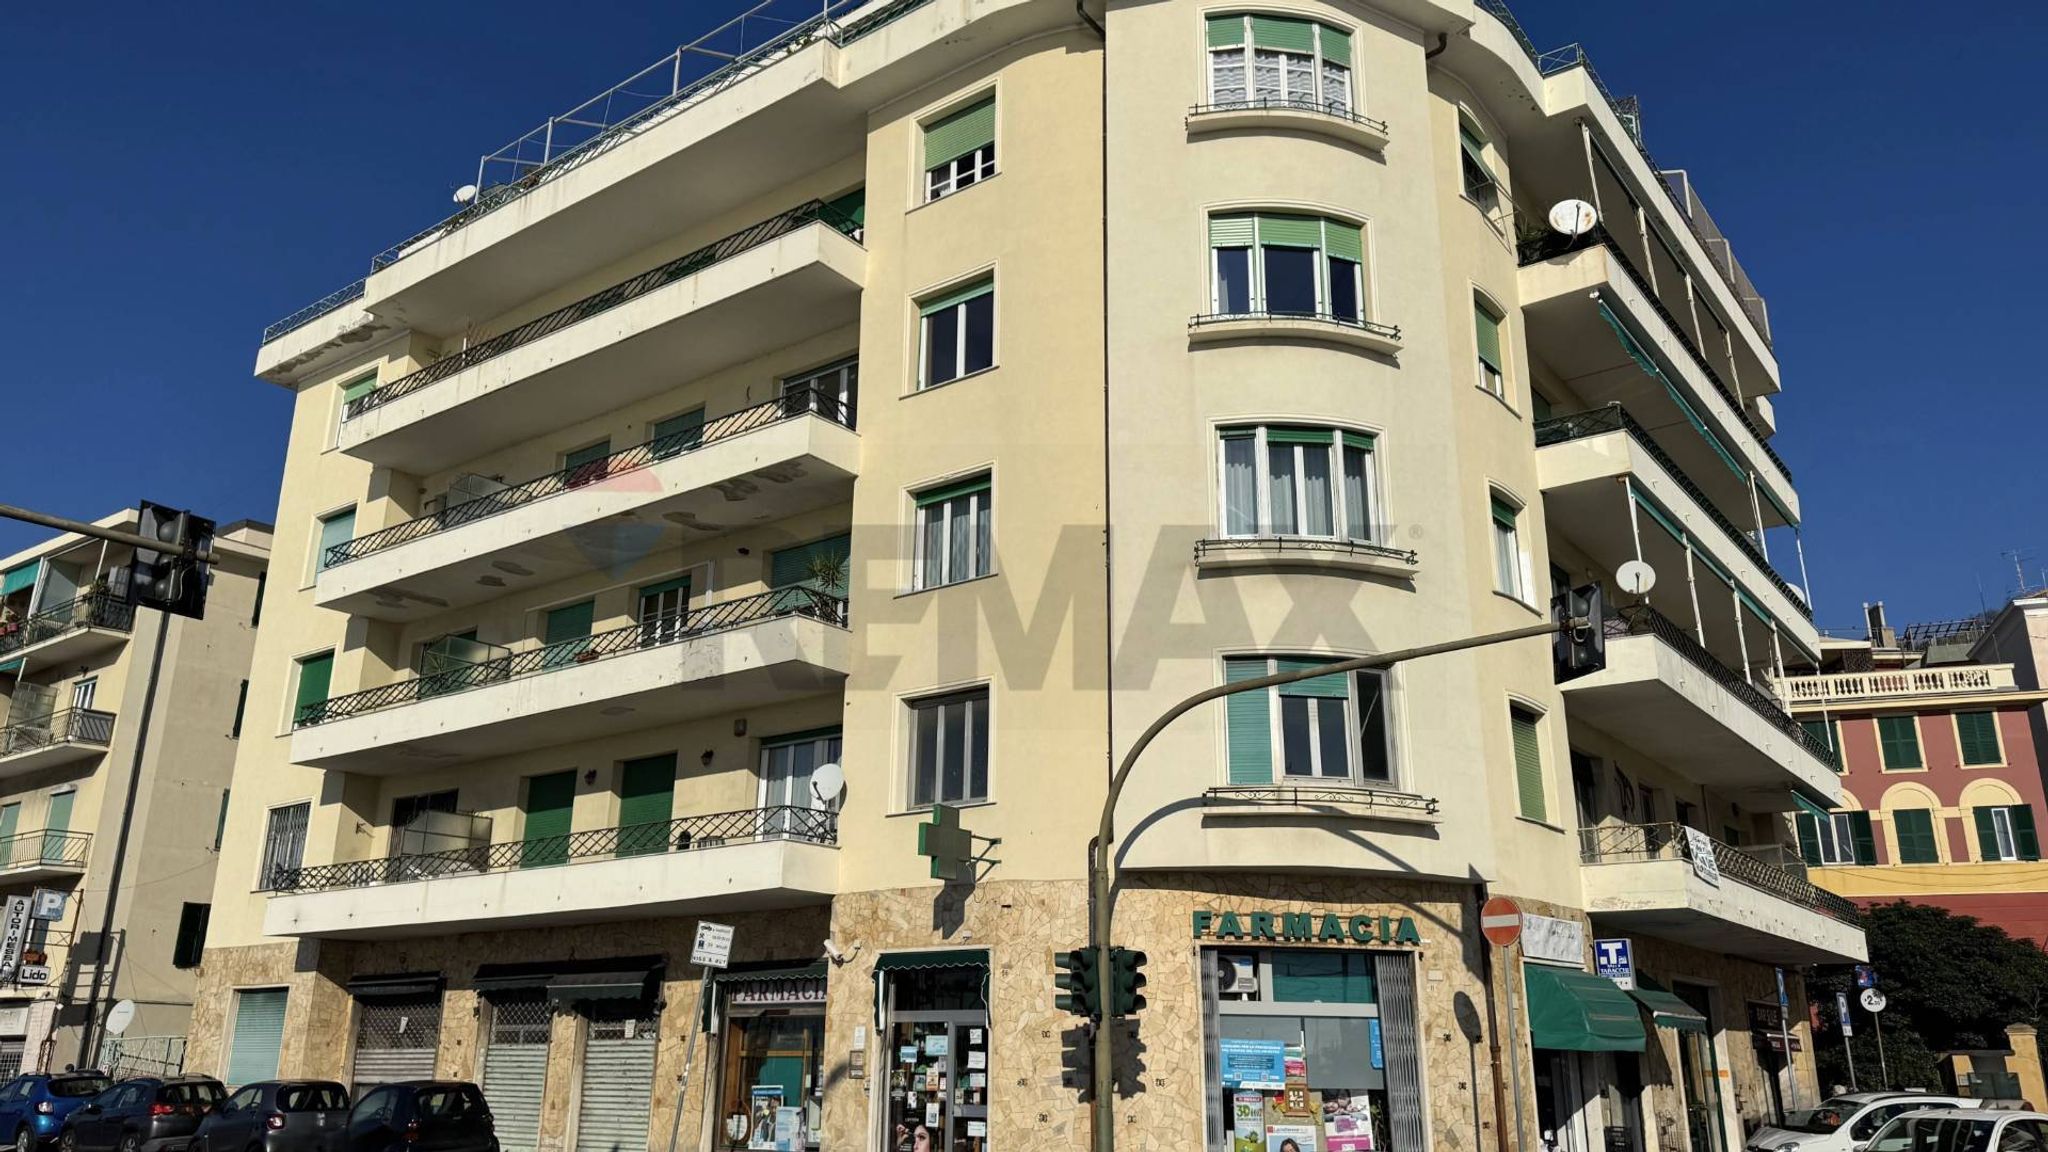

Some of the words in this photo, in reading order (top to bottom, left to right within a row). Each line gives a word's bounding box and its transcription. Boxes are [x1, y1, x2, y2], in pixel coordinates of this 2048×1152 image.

[39, 893, 63, 916] P
[2, 899, 25, 968] AUTORIMESSA
[1193, 911, 1420, 945] FARMACIA
[21, 968, 47, 980] Lido
